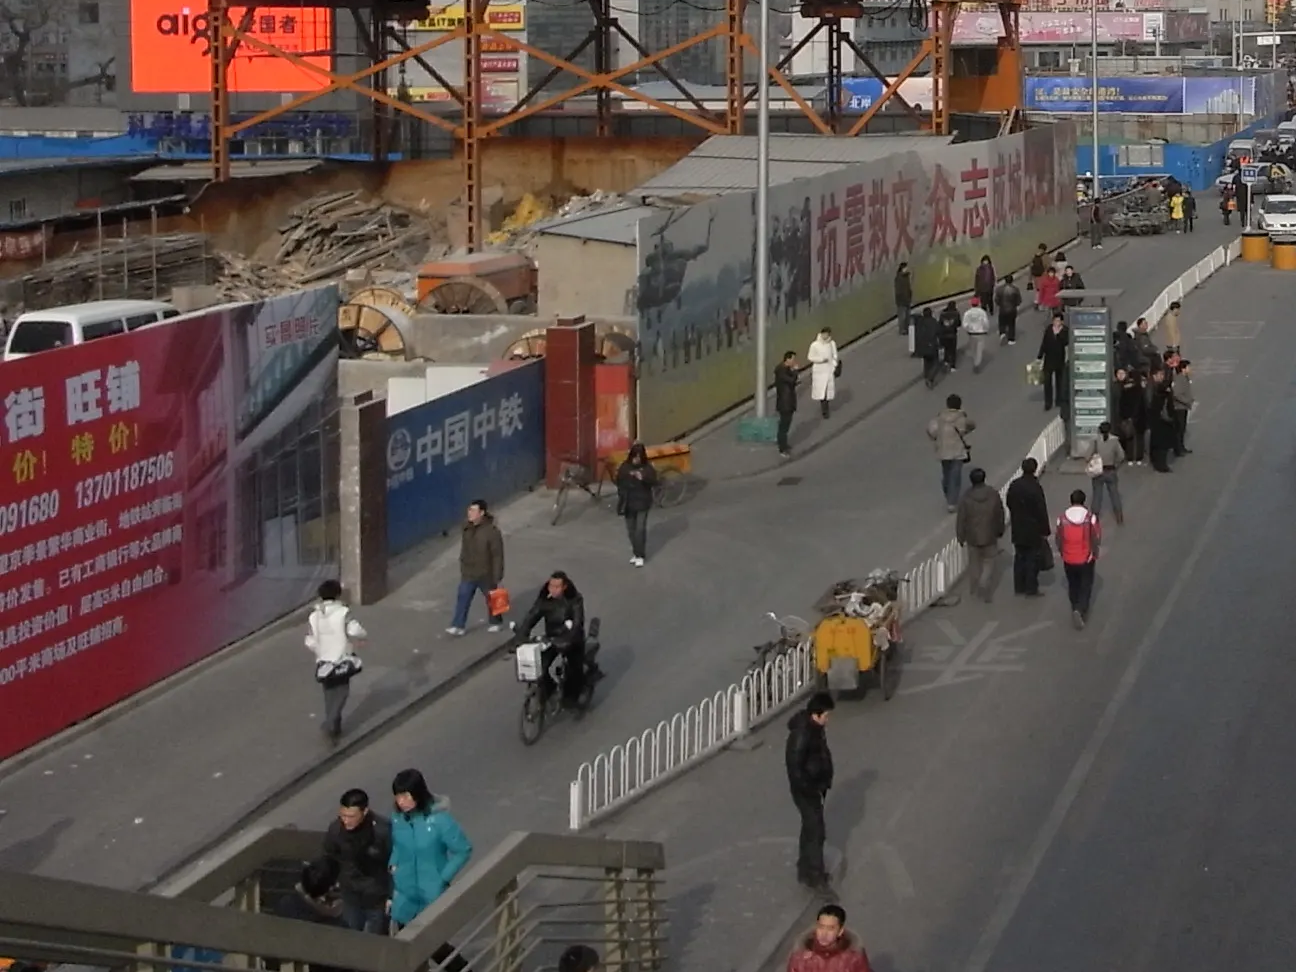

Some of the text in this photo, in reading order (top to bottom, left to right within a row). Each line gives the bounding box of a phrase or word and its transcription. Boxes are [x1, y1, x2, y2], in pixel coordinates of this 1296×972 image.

[816, 170, 915, 294] 抗震救灾
[4, 360, 141, 443] 街 旺铺
[416, 392, 524, 474] 中国中铁
[75, 451, 175, 509] 13701187506
